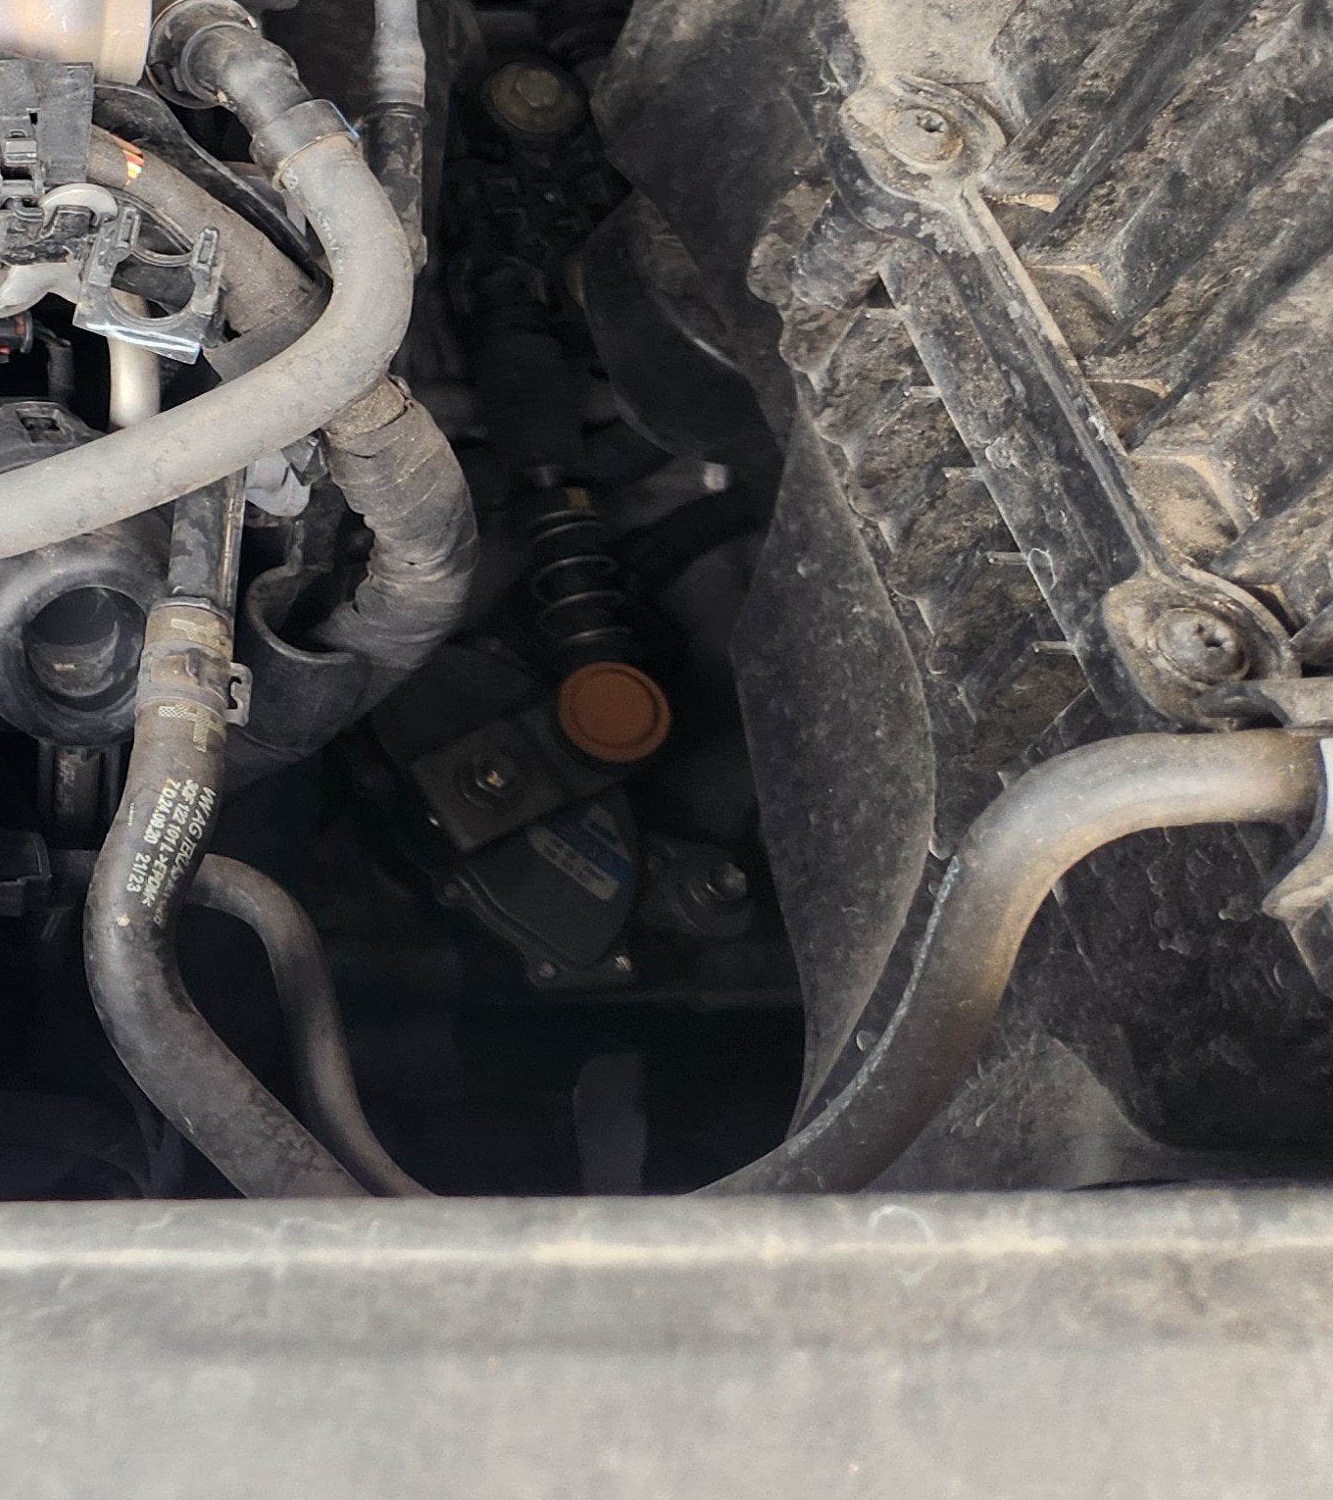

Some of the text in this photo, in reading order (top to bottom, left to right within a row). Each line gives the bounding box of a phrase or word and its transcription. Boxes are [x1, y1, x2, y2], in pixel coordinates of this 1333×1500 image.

[171, 802, 189, 824] 122
[197, 785, 216, 815] VW
[163, 823, 181, 844] 101
[188, 809, 206, 840] AG
[124, 852, 151, 894] 21/23
